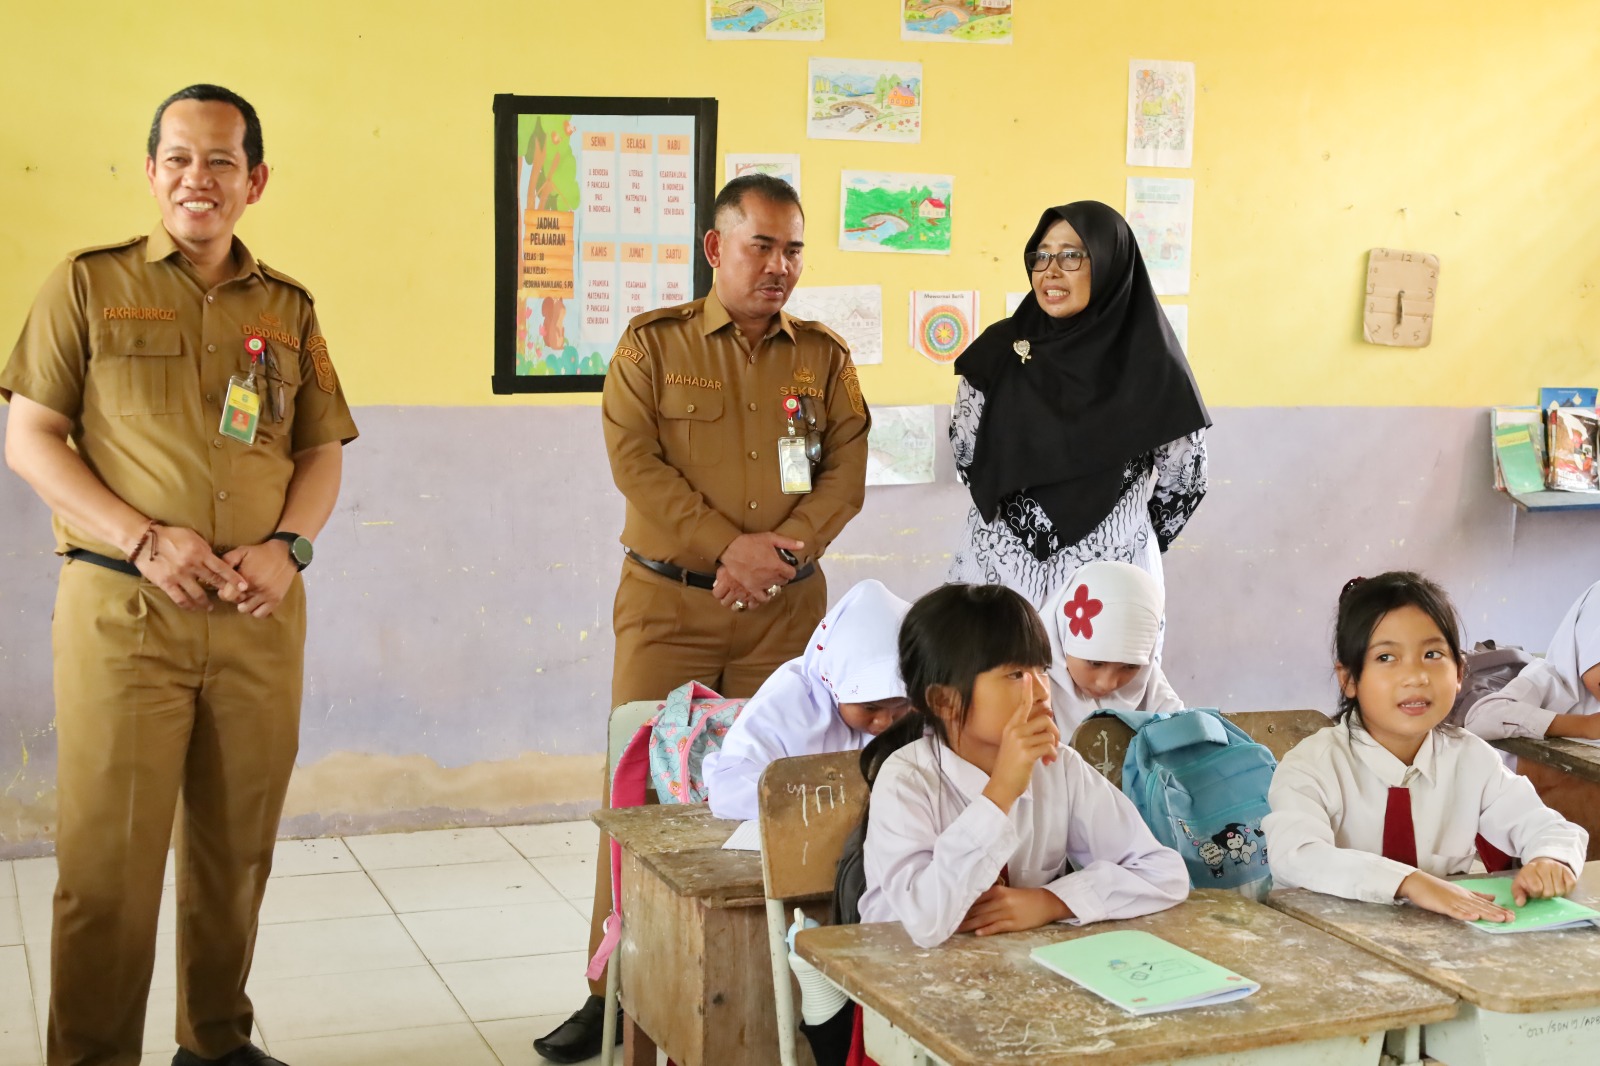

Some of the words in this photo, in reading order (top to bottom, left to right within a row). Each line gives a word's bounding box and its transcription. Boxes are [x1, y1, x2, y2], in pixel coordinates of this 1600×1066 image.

[590, 136, 606, 147] SENIN
[626, 138, 646, 149] SELASA
[667, 140, 681, 150] RABU
[625, 194, 647, 202] MATEMATIKA
[593, 205, 611, 213] INDONESIA
[536, 217, 560, 230] JADWAL
[530, 233, 566, 246] PELAJARAN
[524, 253, 536, 261] KELAS
[591, 247, 607, 257] KAMIS
[629, 248, 644, 258] JUMAT
[666, 249, 682, 259] SABTU
[1401, 253, 1412, 263] 12
[587, 292, 609, 300] MATEMATIKA
[1427, 288, 1434, 300] 3
[1369, 302, 1375, 313] 8
[103, 307, 176, 321] FAKHRURROZI
[243, 324, 300, 349] DISDIKBUD
[1392, 324, 1400, 340] 6
[1413, 330, 1421, 341] 5
[665, 373, 722, 391] MAHADAR
[779, 386, 824, 400] SEKDA
